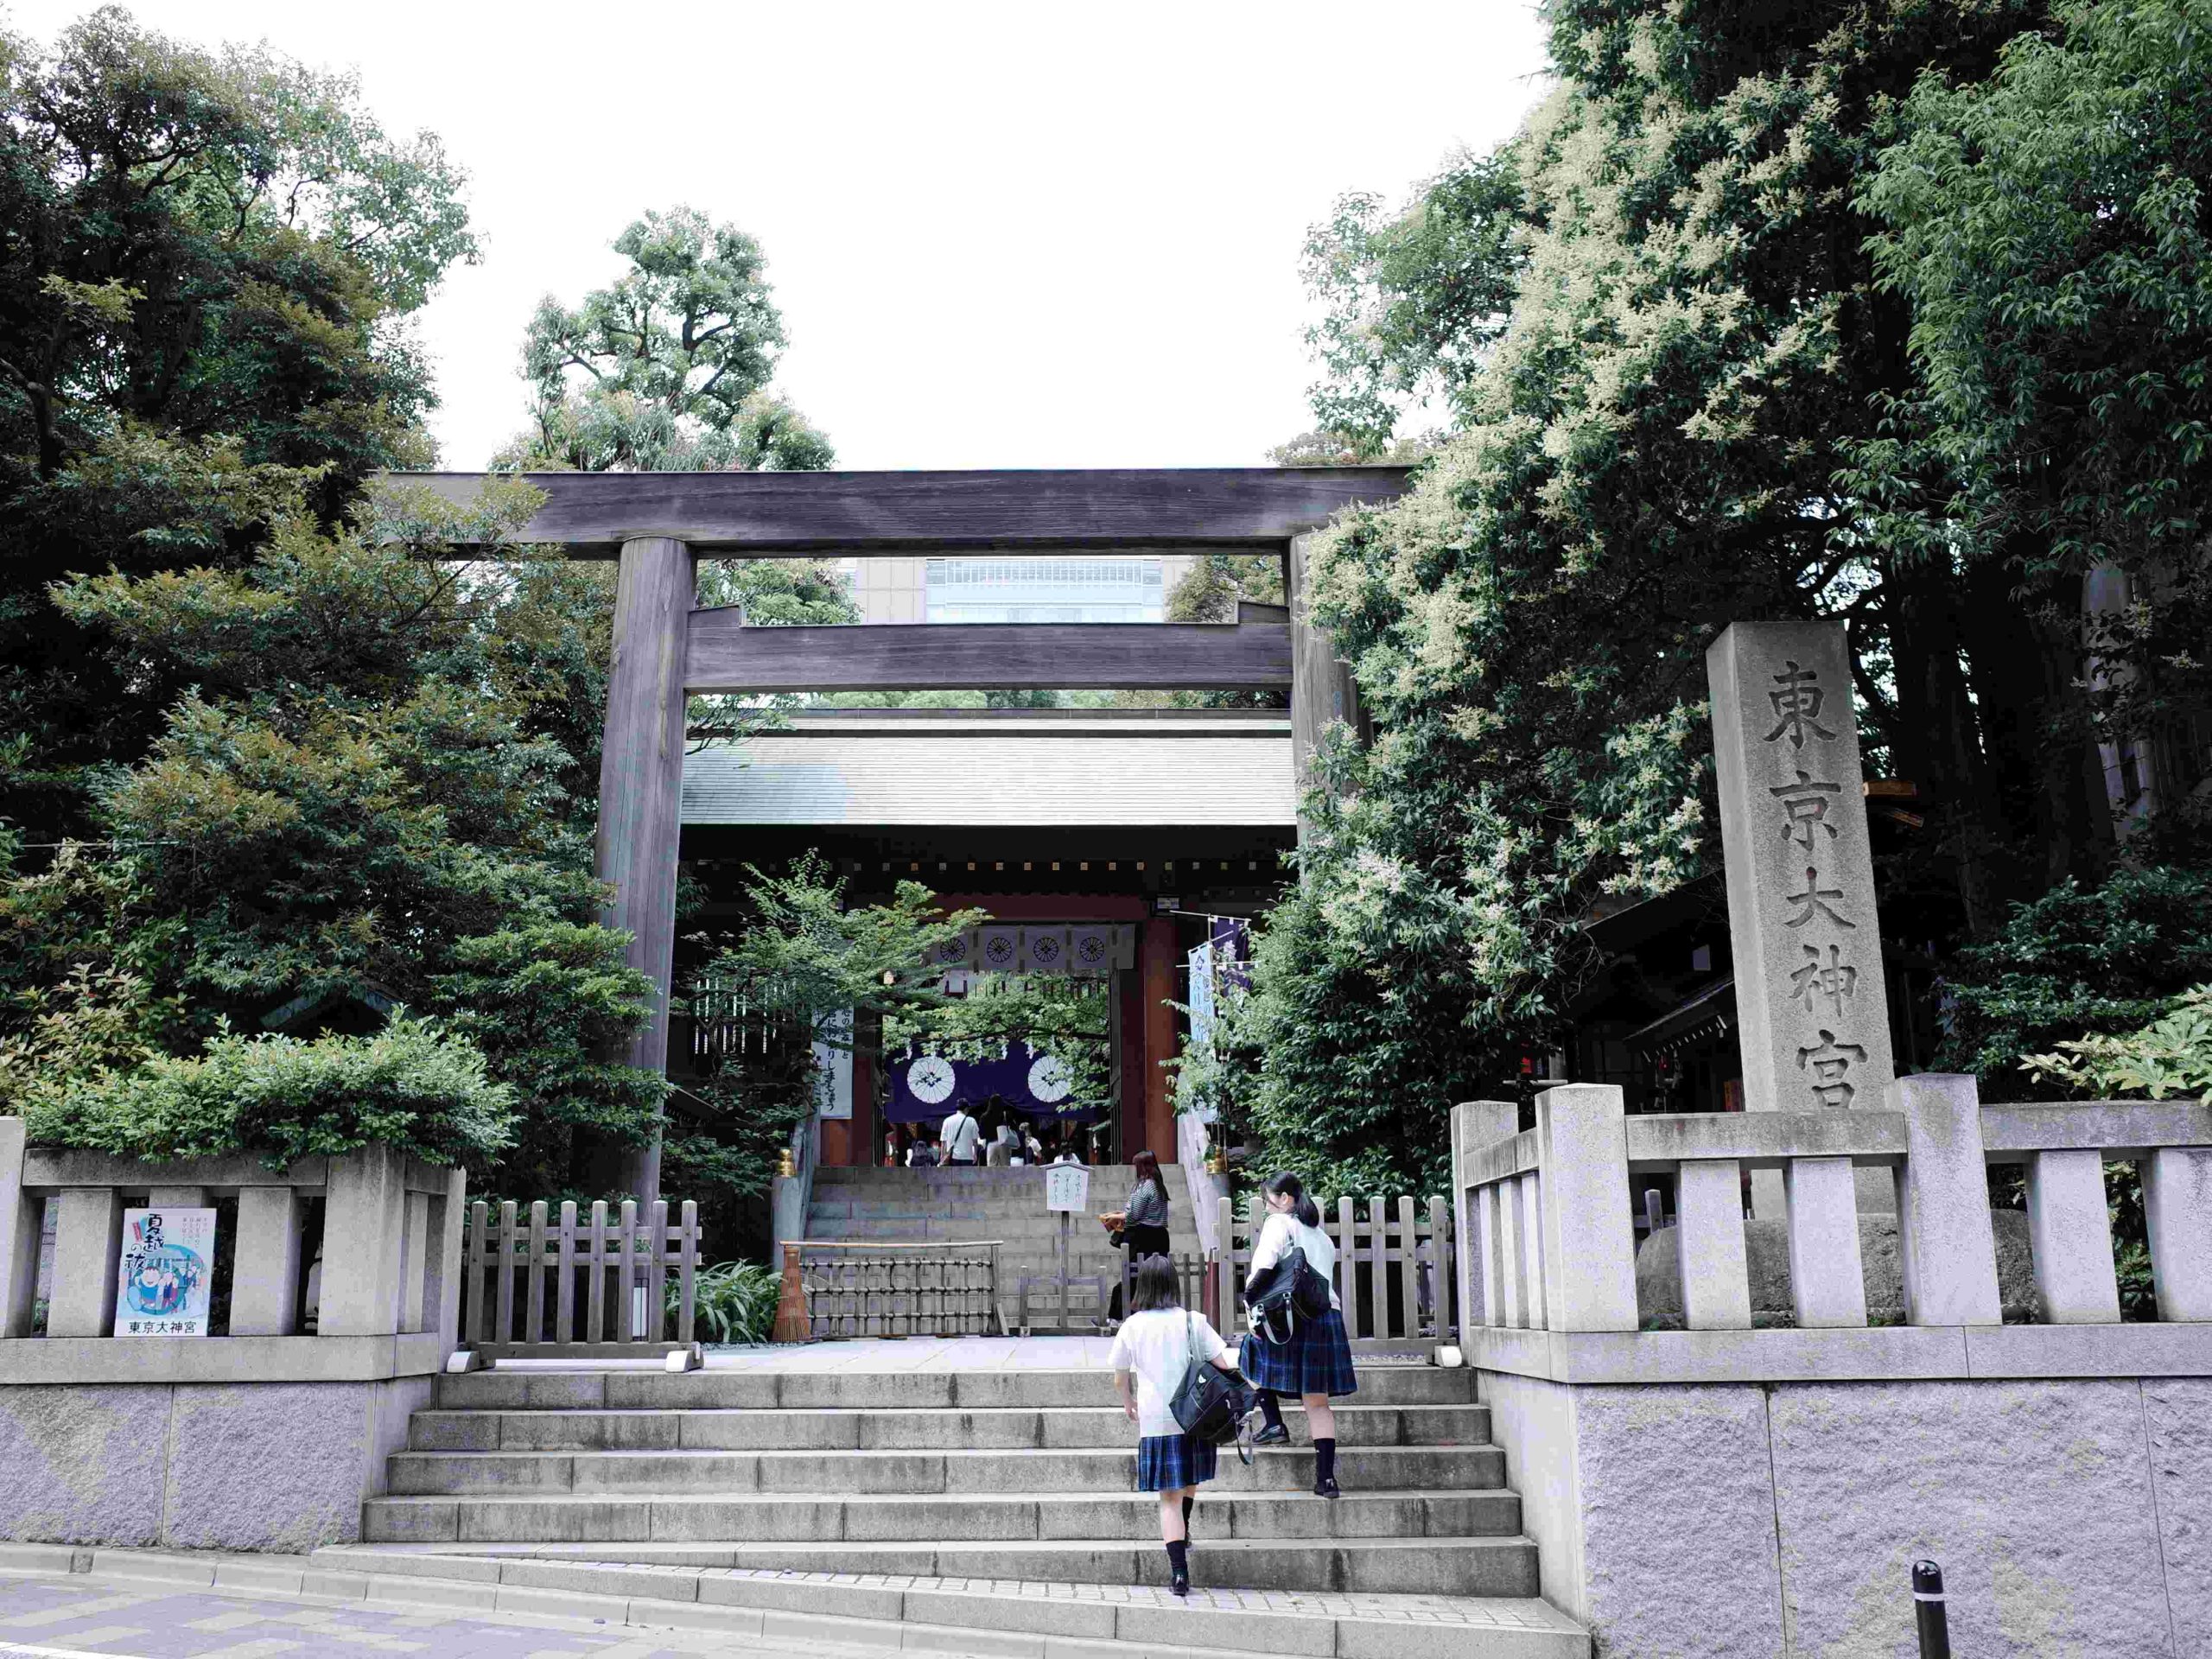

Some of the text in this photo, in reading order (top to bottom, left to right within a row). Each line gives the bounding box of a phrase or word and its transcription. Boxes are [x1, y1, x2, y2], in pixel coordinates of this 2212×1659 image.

[1764, 660, 1868, 1111] 東京大神宮
[128, 1321, 197, 1334] 東京大神宮
